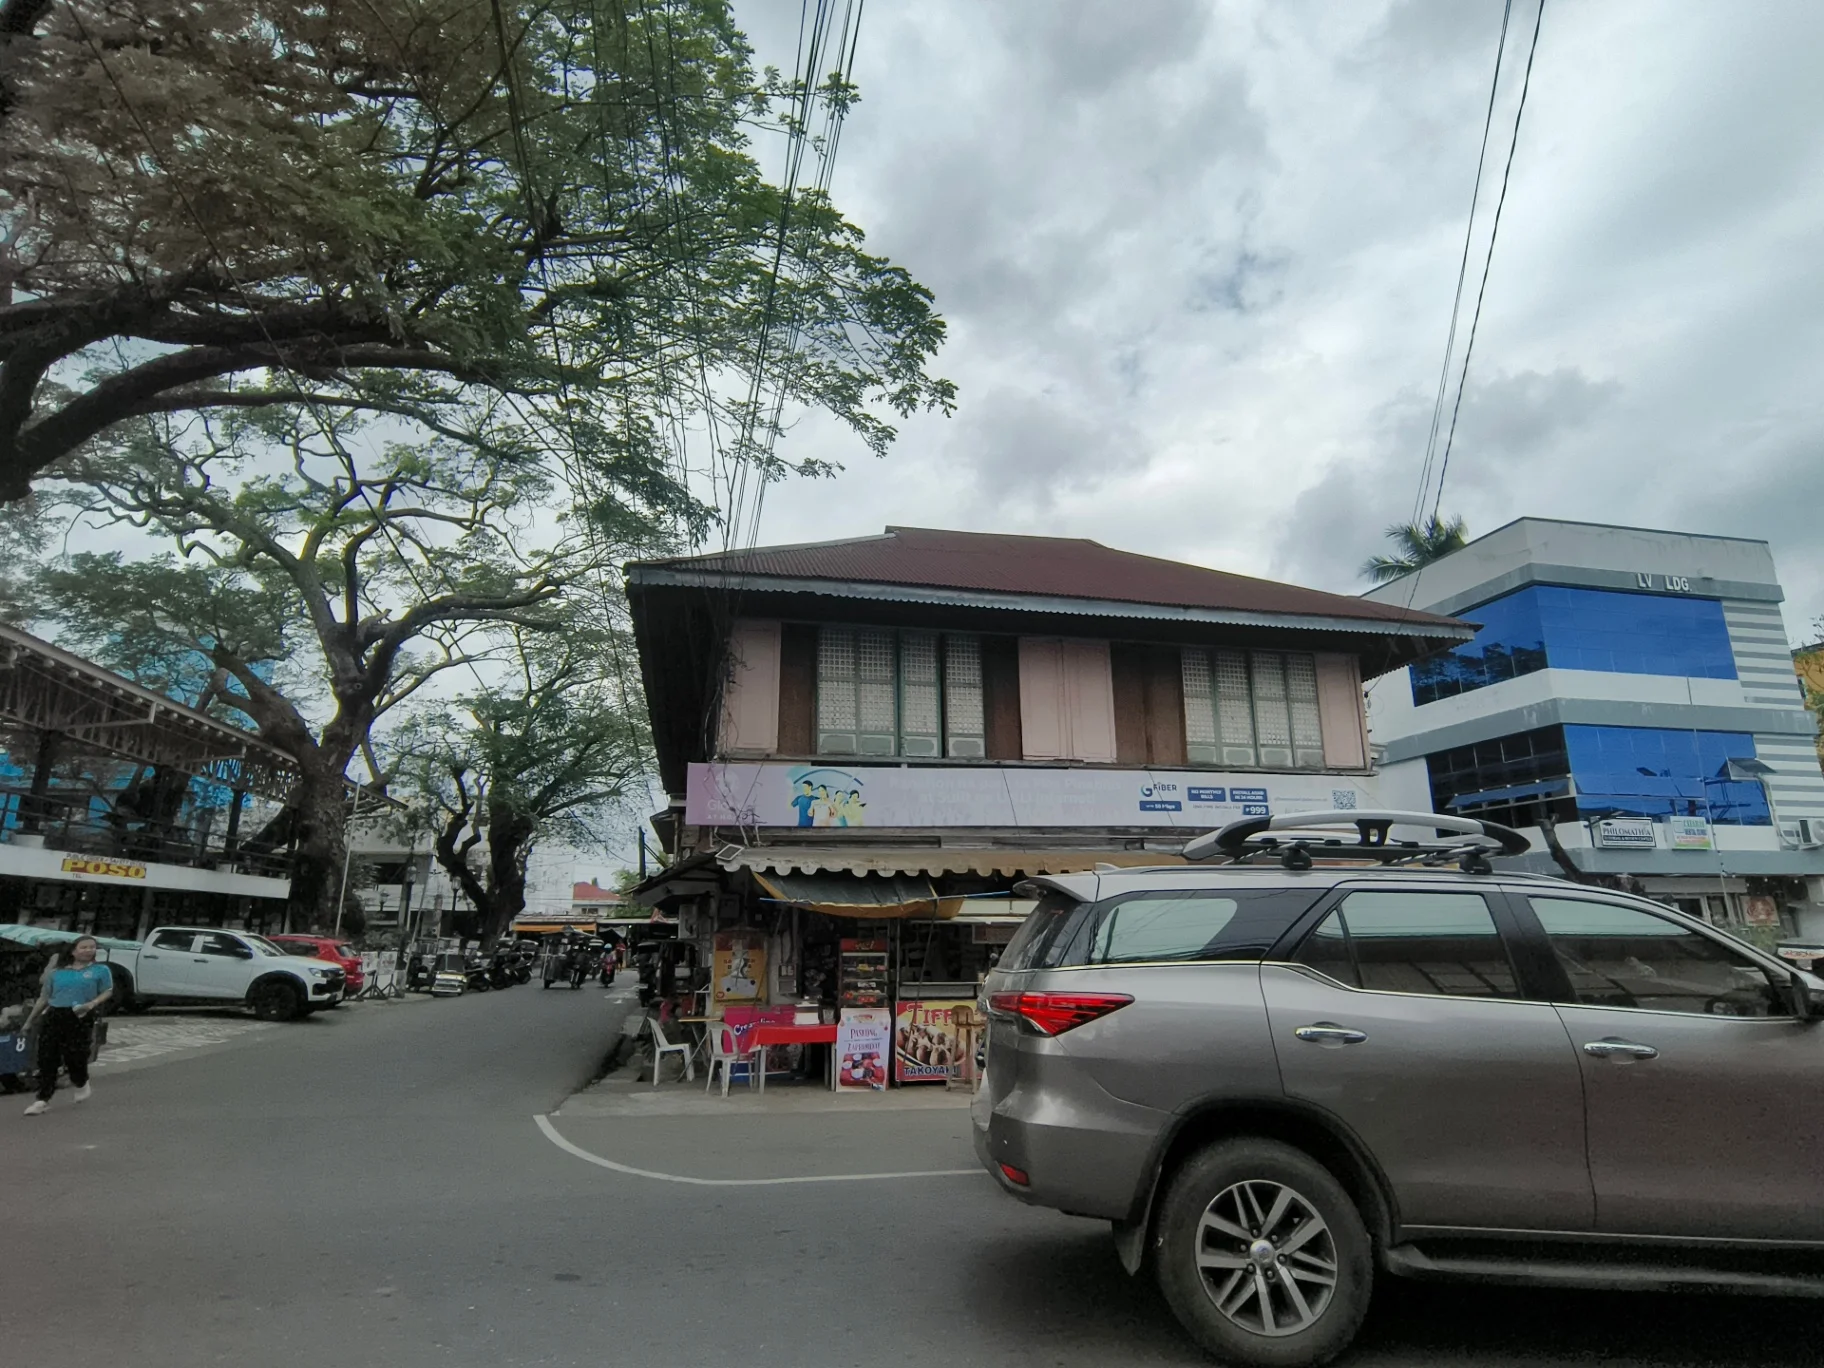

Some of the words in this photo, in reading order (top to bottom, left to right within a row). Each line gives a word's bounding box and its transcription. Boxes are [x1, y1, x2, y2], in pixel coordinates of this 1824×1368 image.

[1637, 573, 1652, 588] LV
[63, 859, 146, 878] POSO
[16, 1037, 26, 1052] 8
